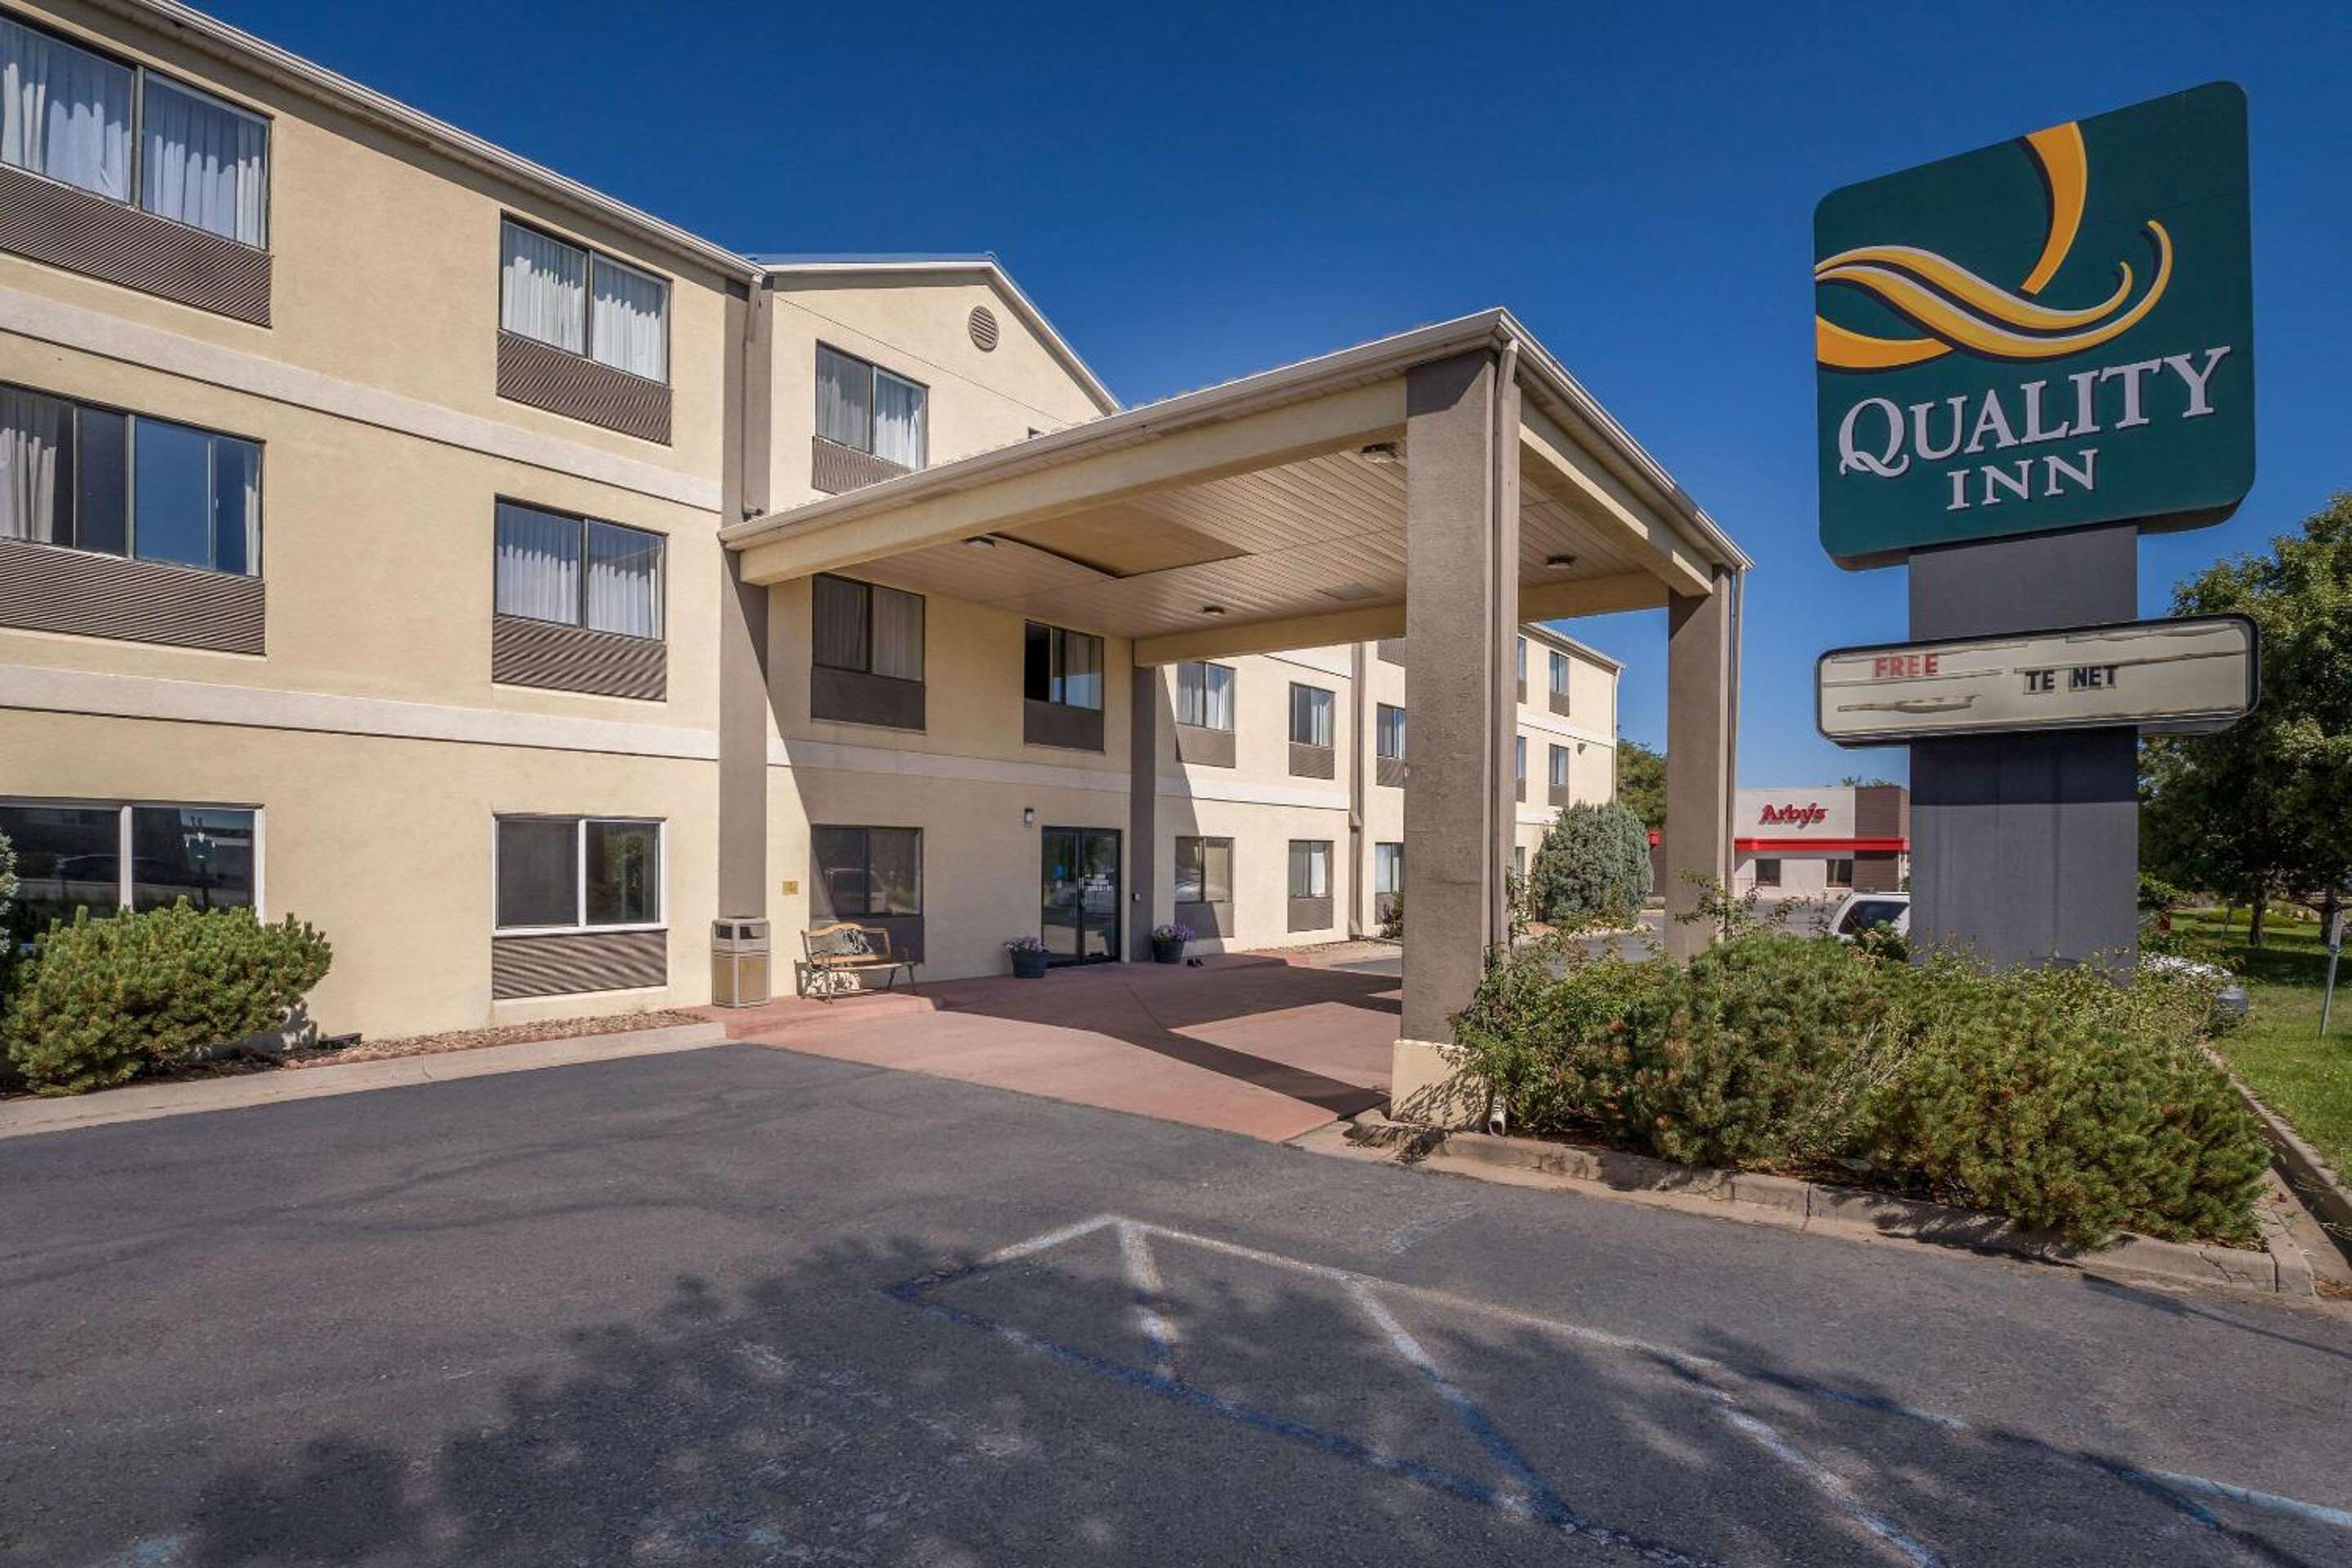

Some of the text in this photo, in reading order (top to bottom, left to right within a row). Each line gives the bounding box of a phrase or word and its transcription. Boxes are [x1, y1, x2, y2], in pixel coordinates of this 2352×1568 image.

[1838, 345, 2231, 478] QUALITY
[1947, 448, 2099, 510] INN
[1873, 653, 1940, 678] FREE
[2025, 664, 2119, 691] TE NET
[1759, 802, 1829, 830] Arby's
